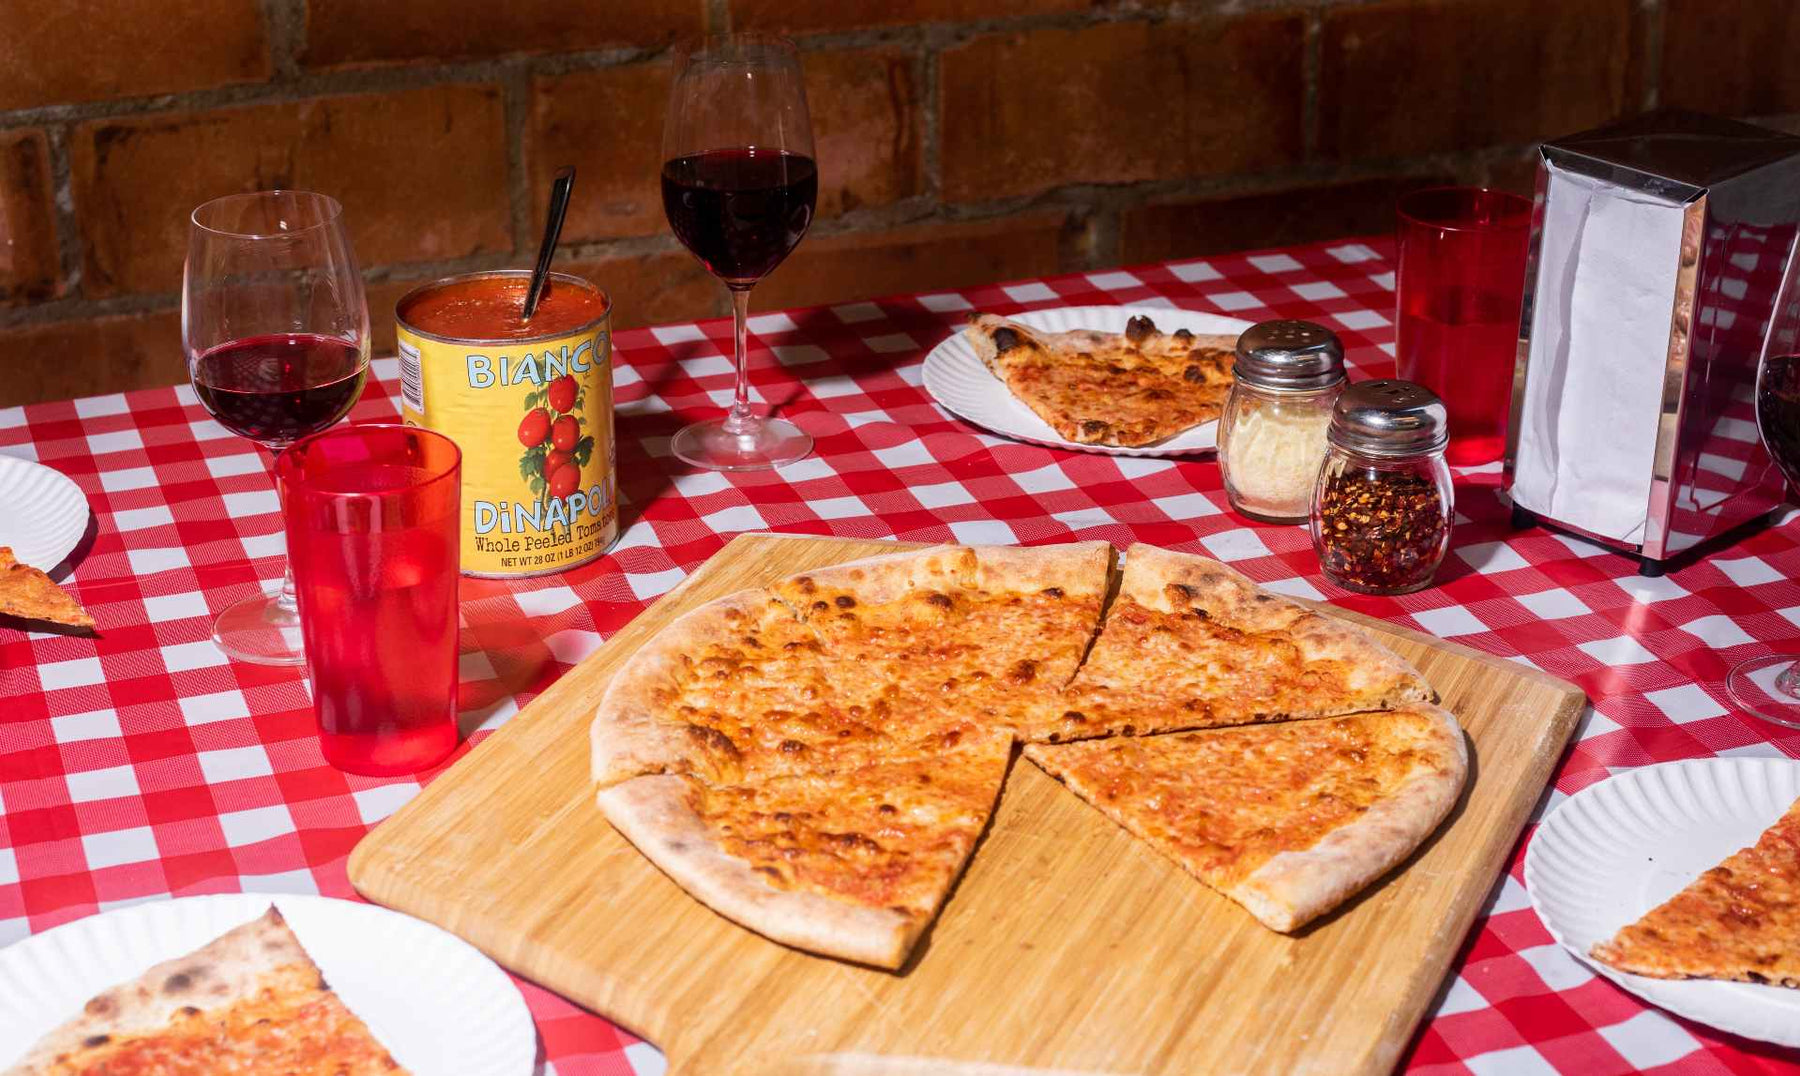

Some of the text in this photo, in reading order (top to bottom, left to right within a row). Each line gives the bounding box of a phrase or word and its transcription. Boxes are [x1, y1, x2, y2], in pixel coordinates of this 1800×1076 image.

[466, 330, 608, 388] BIANCO
[475, 536, 520, 553] Whole
[524, 530, 572, 551] Peeled
[501, 557, 518, 567] NET
[519, 556, 532, 566] WT
[534, 555, 543, 565] 28
[544, 552, 556, 563] OZ
[556, 551, 564, 562] (1
[565, 548, 574, 558] LB
[575, 546, 583, 556] 12
[583, 541, 594, 552] OZ)
